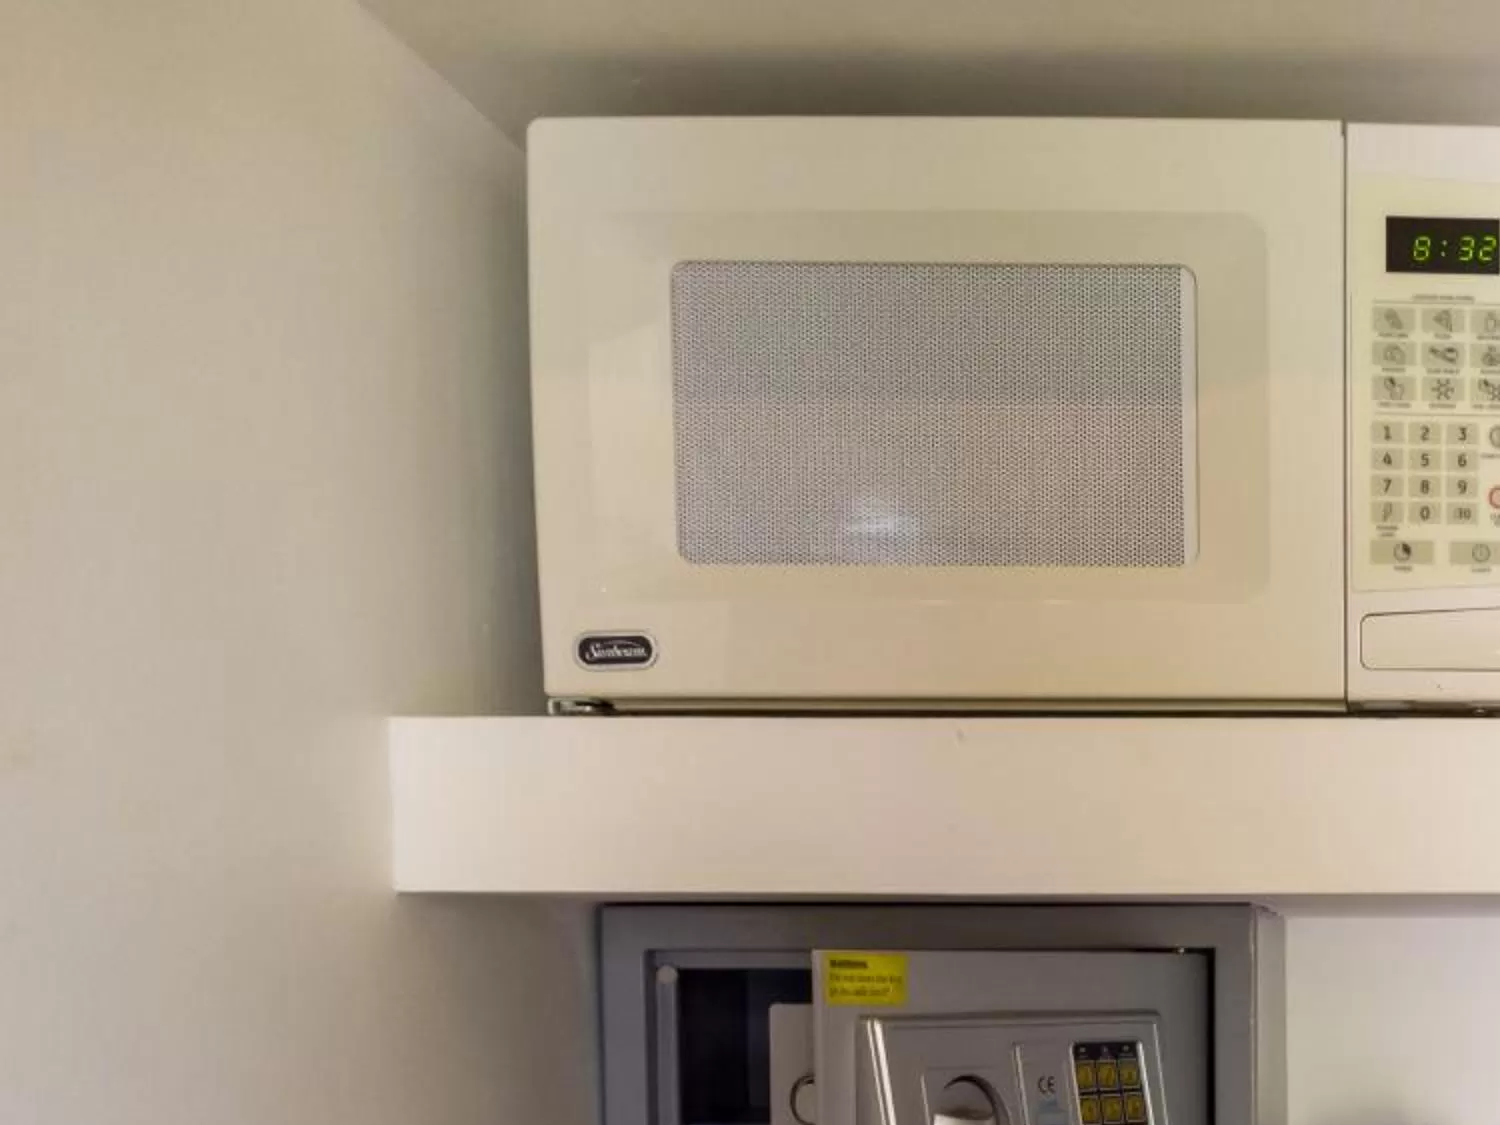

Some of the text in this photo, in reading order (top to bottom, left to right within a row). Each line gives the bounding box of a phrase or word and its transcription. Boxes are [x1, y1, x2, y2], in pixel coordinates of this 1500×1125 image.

[1412, 235, 1498, 262] 8:32
[1382, 425, 1468, 442] 1 2 3
[1381, 451, 1393, 467] 4
[1420, 452, 1430, 468] 5
[1457, 452, 1468, 468] 6
[1382, 477, 1468, 495] 7 8 9
[1419, 505, 1431, 521] 0
[1037, 1075, 1056, 1095] CE
